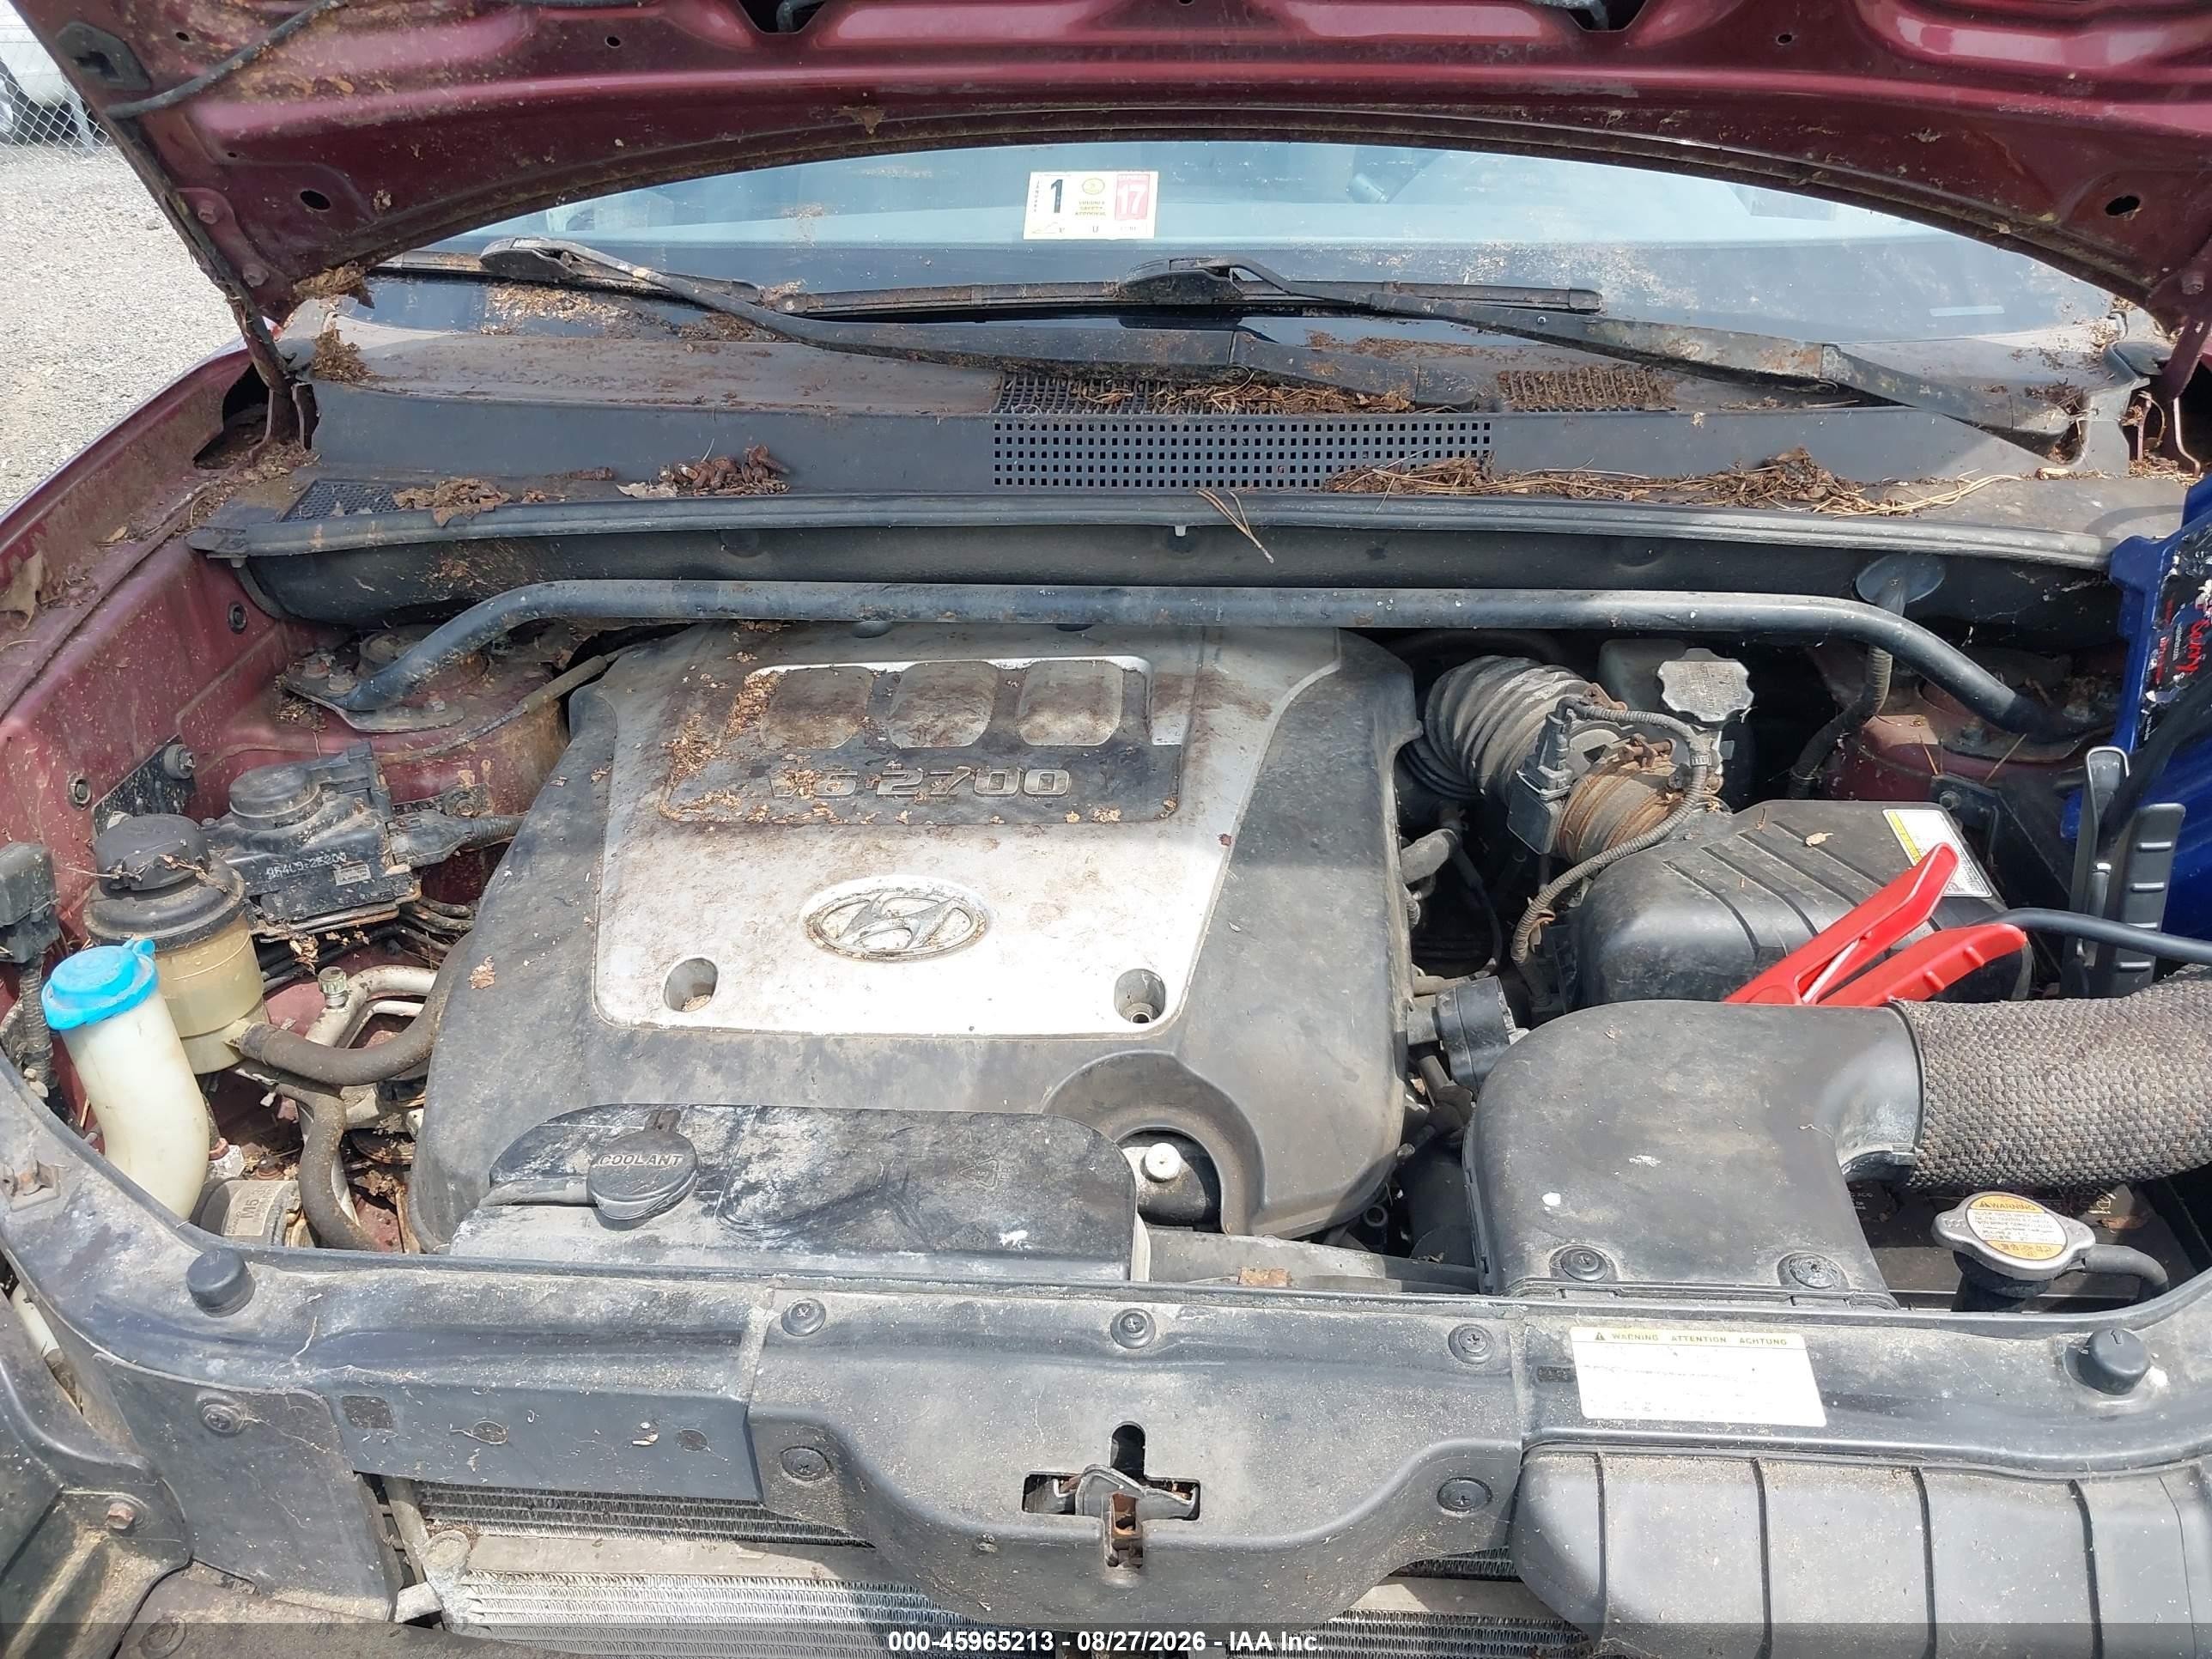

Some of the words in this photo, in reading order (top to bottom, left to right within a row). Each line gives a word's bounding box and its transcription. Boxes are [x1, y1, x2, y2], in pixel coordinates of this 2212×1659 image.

[1050, 179, 1063, 214] 1
[1117, 184, 1146, 215] 17
[599, 1153, 684, 1166] COOLANT
[1991, 1202, 2036, 1211] WARNING
[1612, 1333, 1660, 1342] WARNING
[1671, 1335, 1727, 1344] ATTENTION
[1739, 1337, 1788, 1346] ACHTUNG
